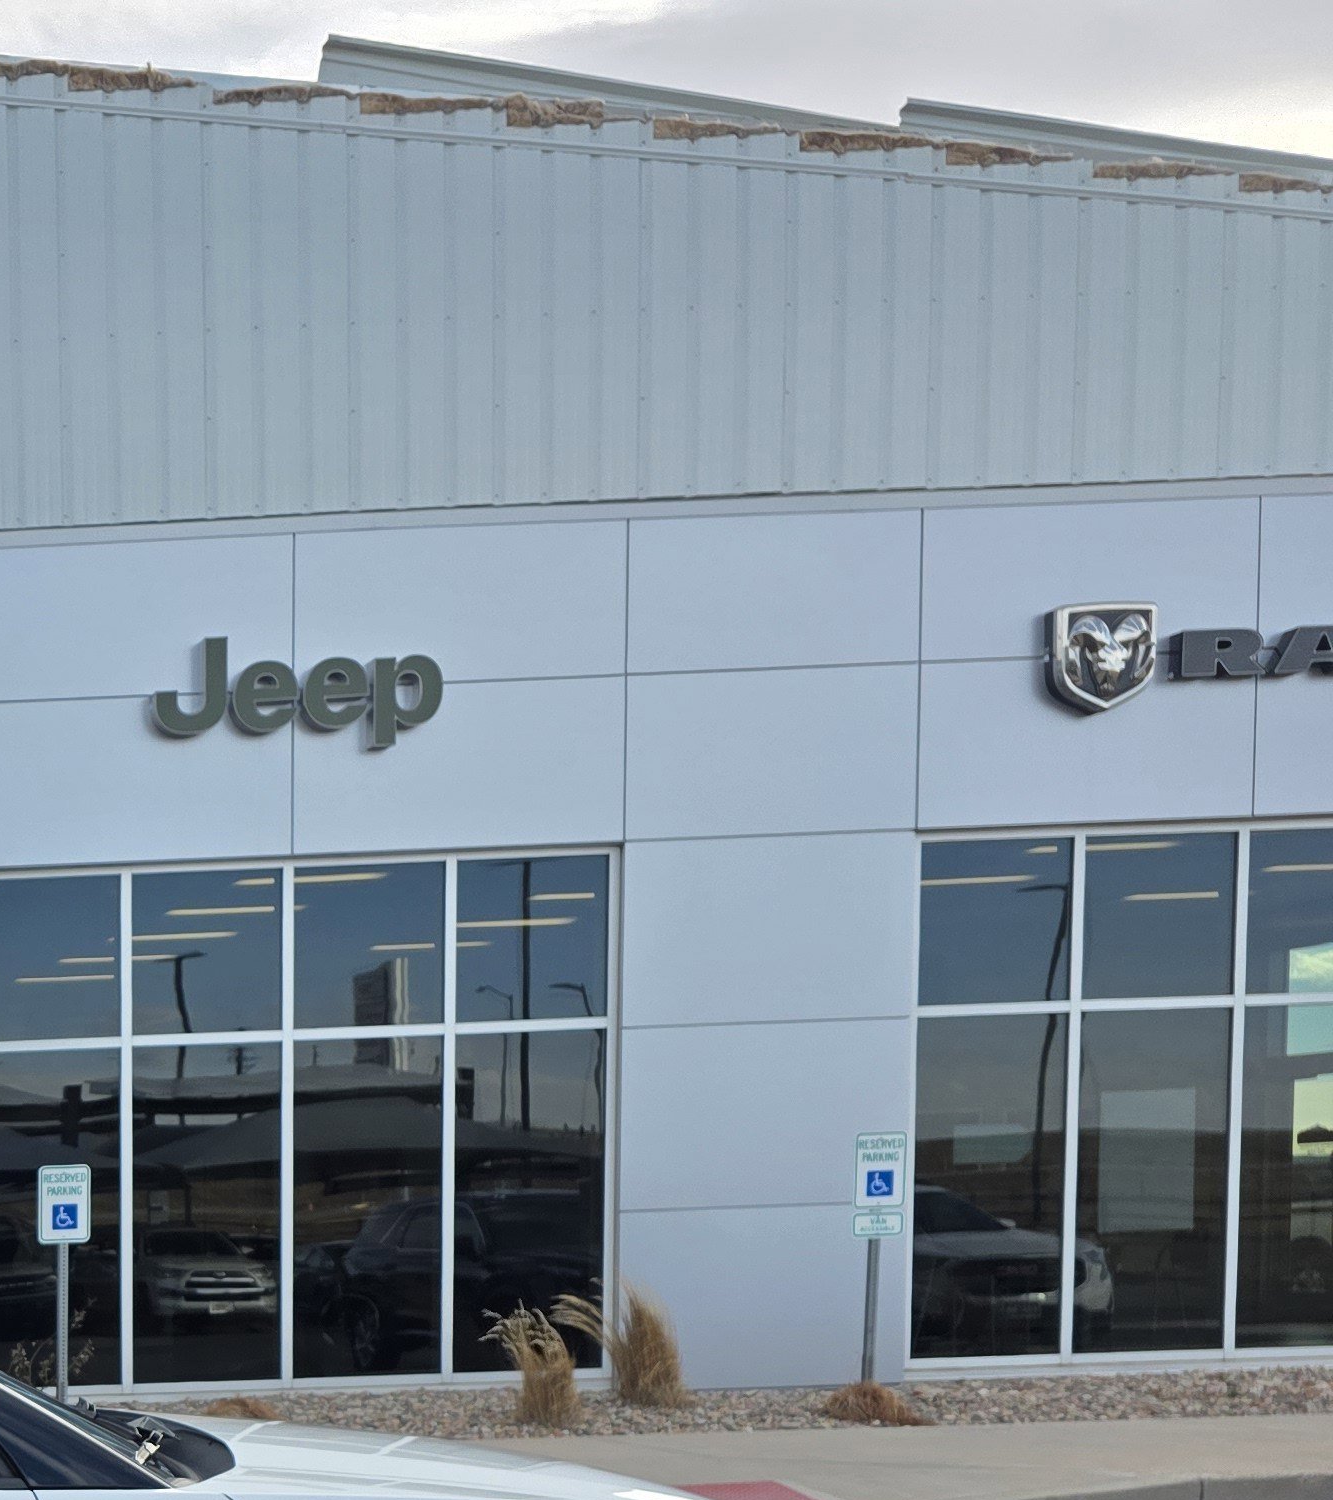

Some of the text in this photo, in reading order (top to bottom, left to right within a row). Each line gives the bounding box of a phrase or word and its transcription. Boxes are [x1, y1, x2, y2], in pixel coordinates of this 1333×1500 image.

[150, 636, 443, 752] Jeep
[858, 1138, 904, 1150] RESERVED
[862, 1151, 899, 1162] PARKING
[43, 1172, 87, 1183] RESERVED
[47, 1185, 82, 1196] PARKING
